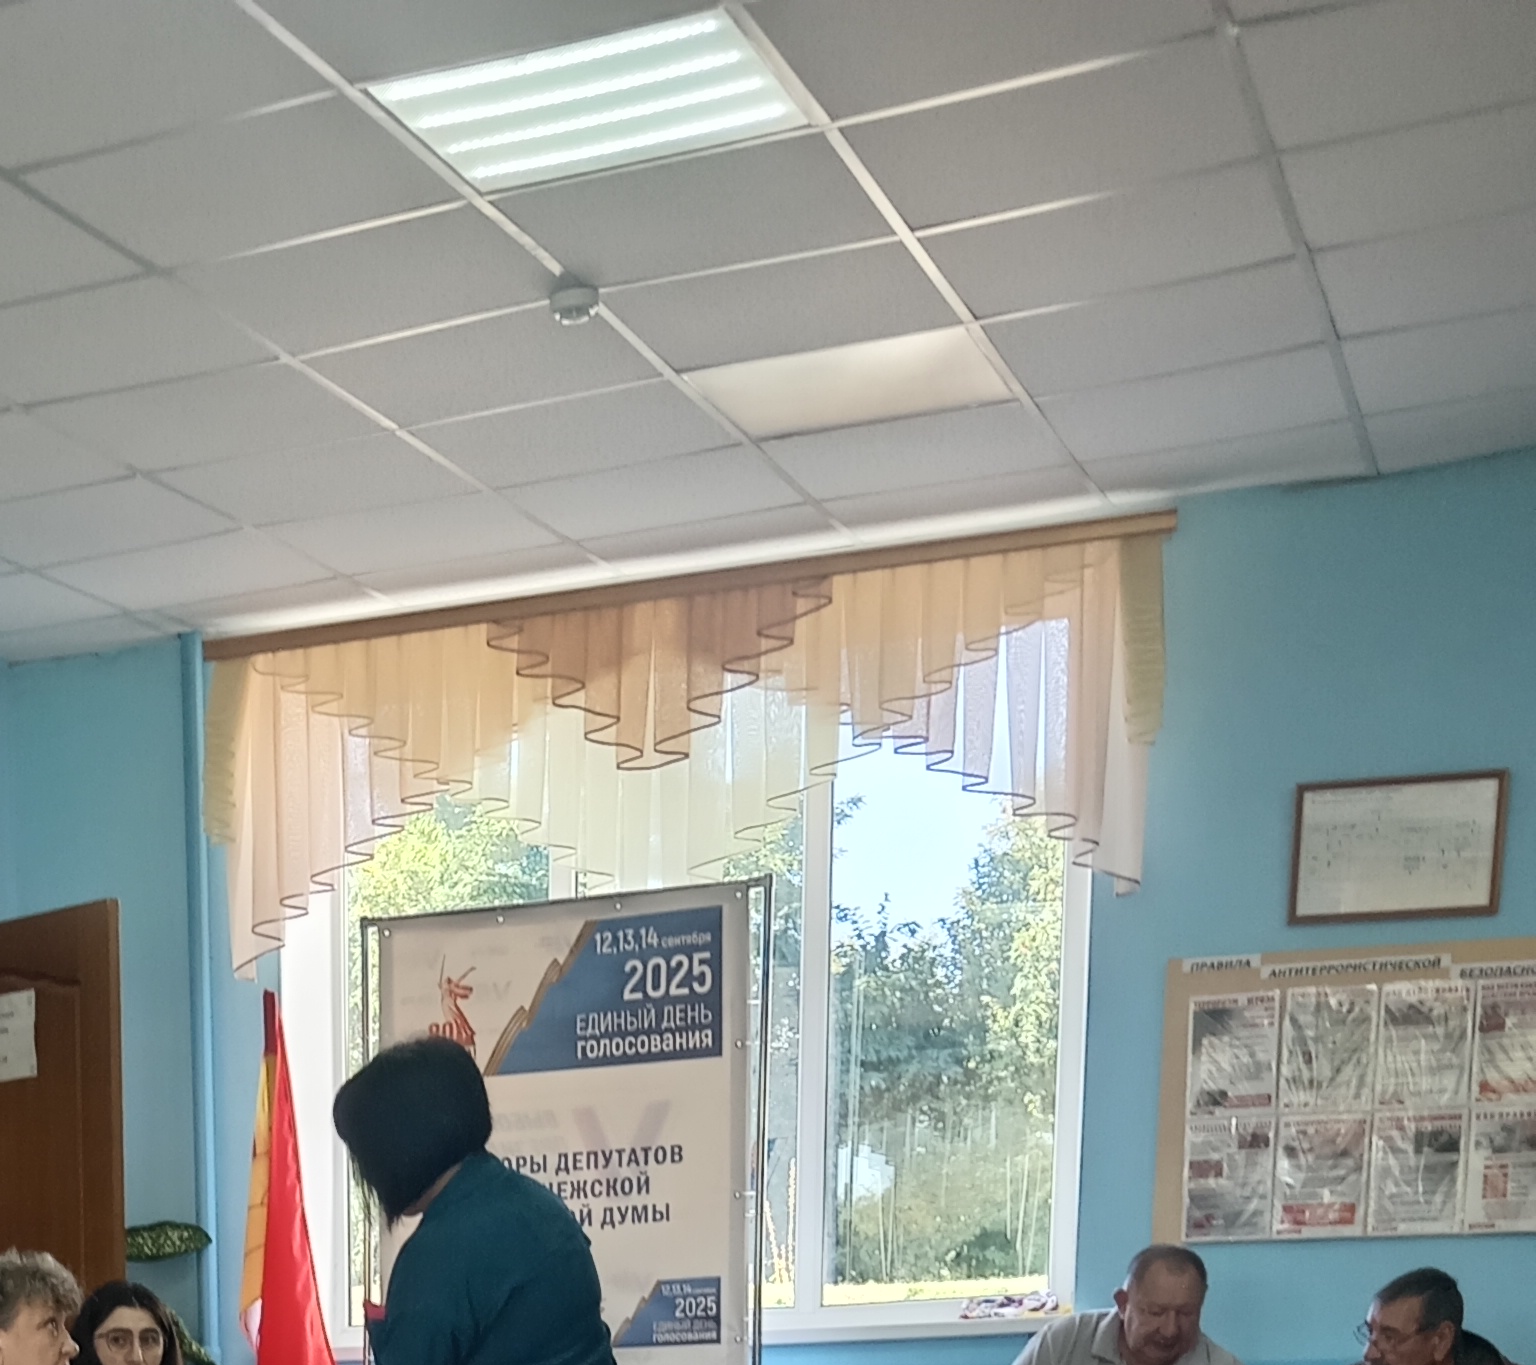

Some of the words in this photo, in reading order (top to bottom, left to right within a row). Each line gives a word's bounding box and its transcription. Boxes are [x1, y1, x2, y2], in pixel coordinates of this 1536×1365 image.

[594, 926, 658, 955] 12,13,14
[661, 931, 712, 948] сентября
[623, 951, 713, 1002] 2025
[1191, 958, 1252, 973] ПРАВИЛА
[575, 1003, 655, 1037] ЕДИНЫЙ
[661, 1002, 713, 1030] ДЕНЬ
[554, 1144, 684, 1176] ДЕПУТАТОВ
[600, 1203, 671, 1229] ДУМЫ
[675, 1295, 717, 1318] 2025
